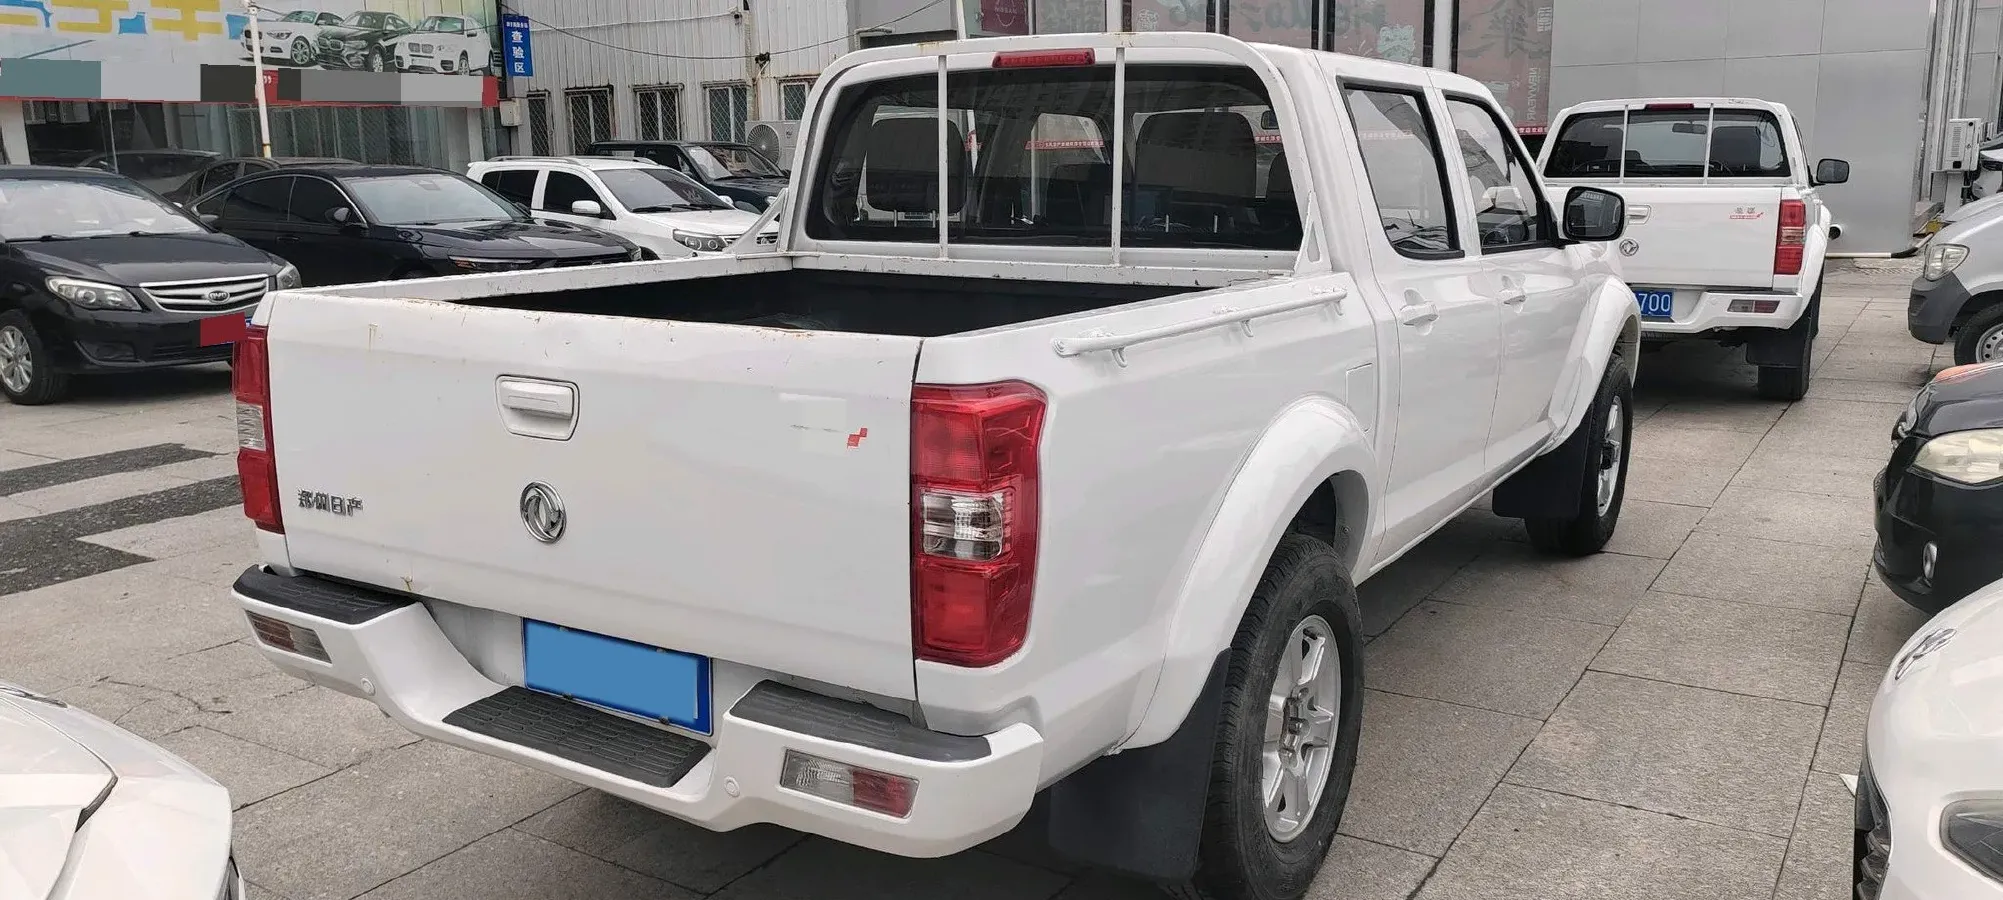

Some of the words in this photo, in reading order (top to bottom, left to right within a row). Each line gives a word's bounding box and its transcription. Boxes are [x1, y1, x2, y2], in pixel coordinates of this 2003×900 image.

[994, 6, 1018, 14] NISSAN
[511, 30, 525, 73] 查验区
[297, 488, 363, 517] 郑州日产
